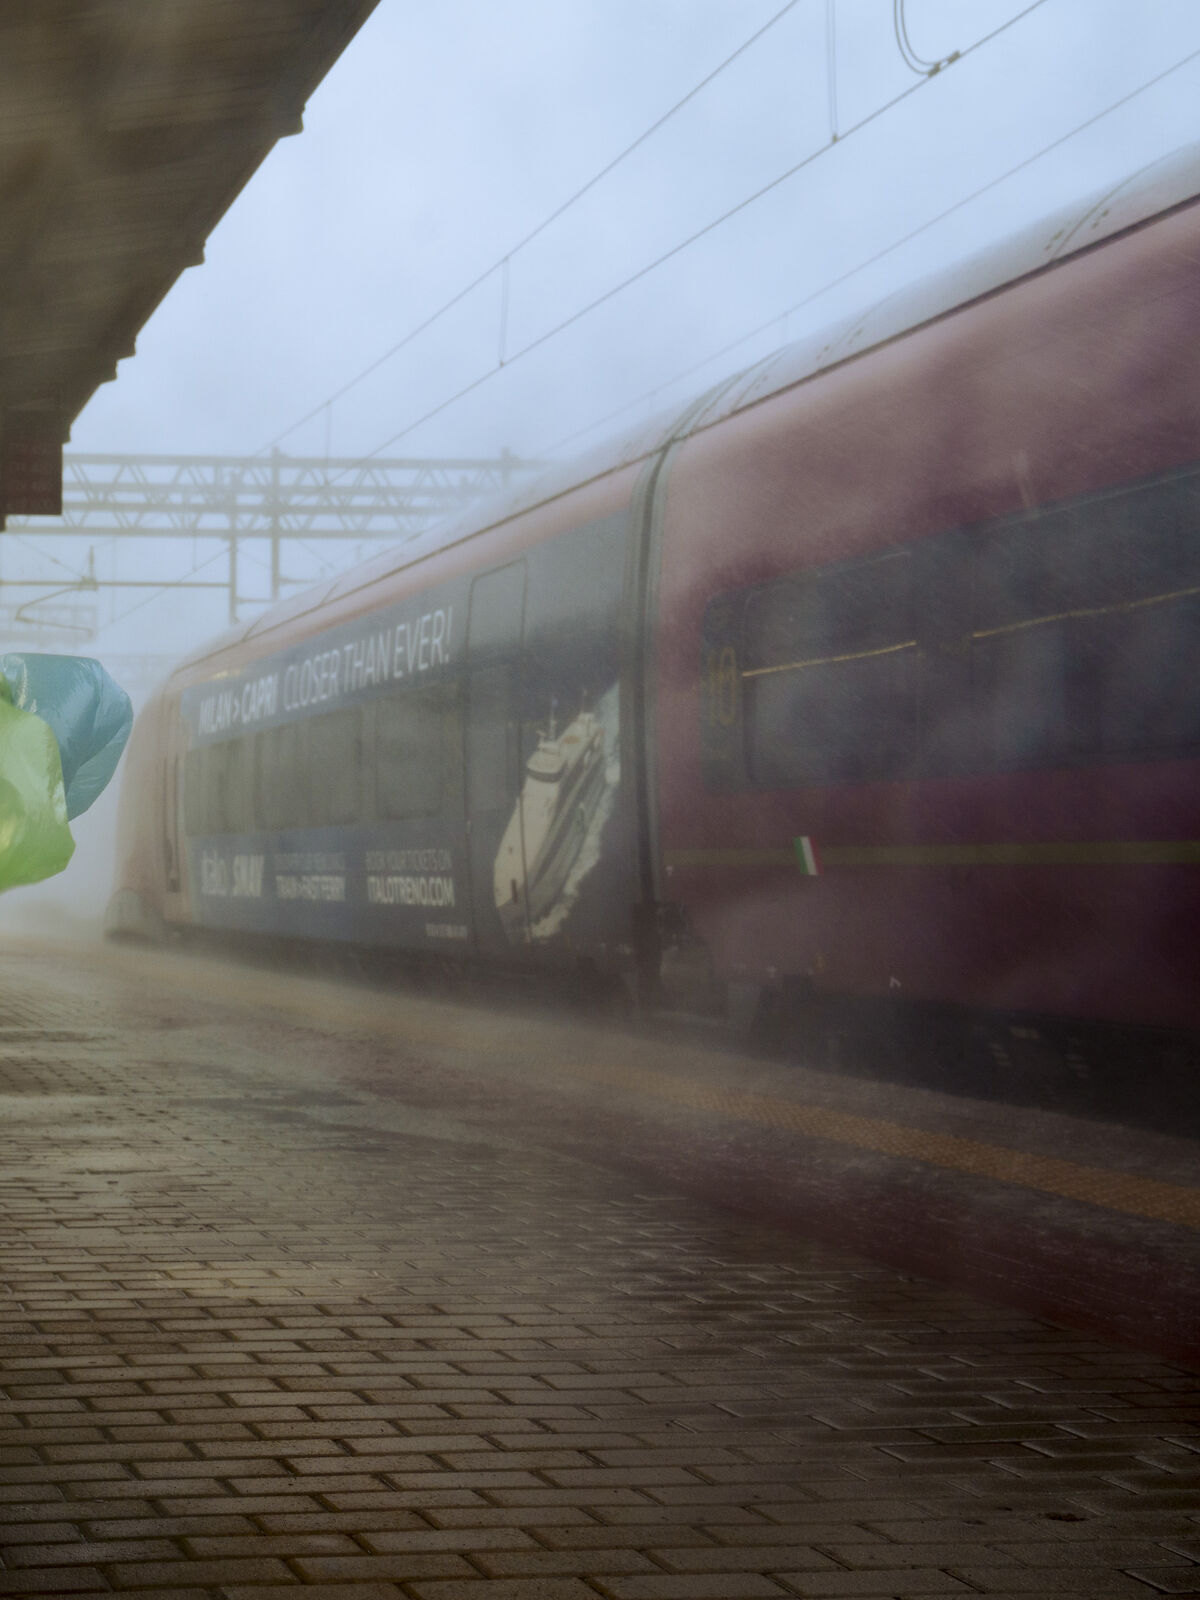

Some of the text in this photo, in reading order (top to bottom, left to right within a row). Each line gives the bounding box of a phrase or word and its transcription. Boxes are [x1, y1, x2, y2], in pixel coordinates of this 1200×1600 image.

[241, 673, 279, 724] CAPRI
[283, 648, 340, 712] CLOSER
[344, 629, 392, 693] THAN
[393, 606, 453, 679] EVER!
[367, 876, 456, 907] ITALOTRENO.COM
